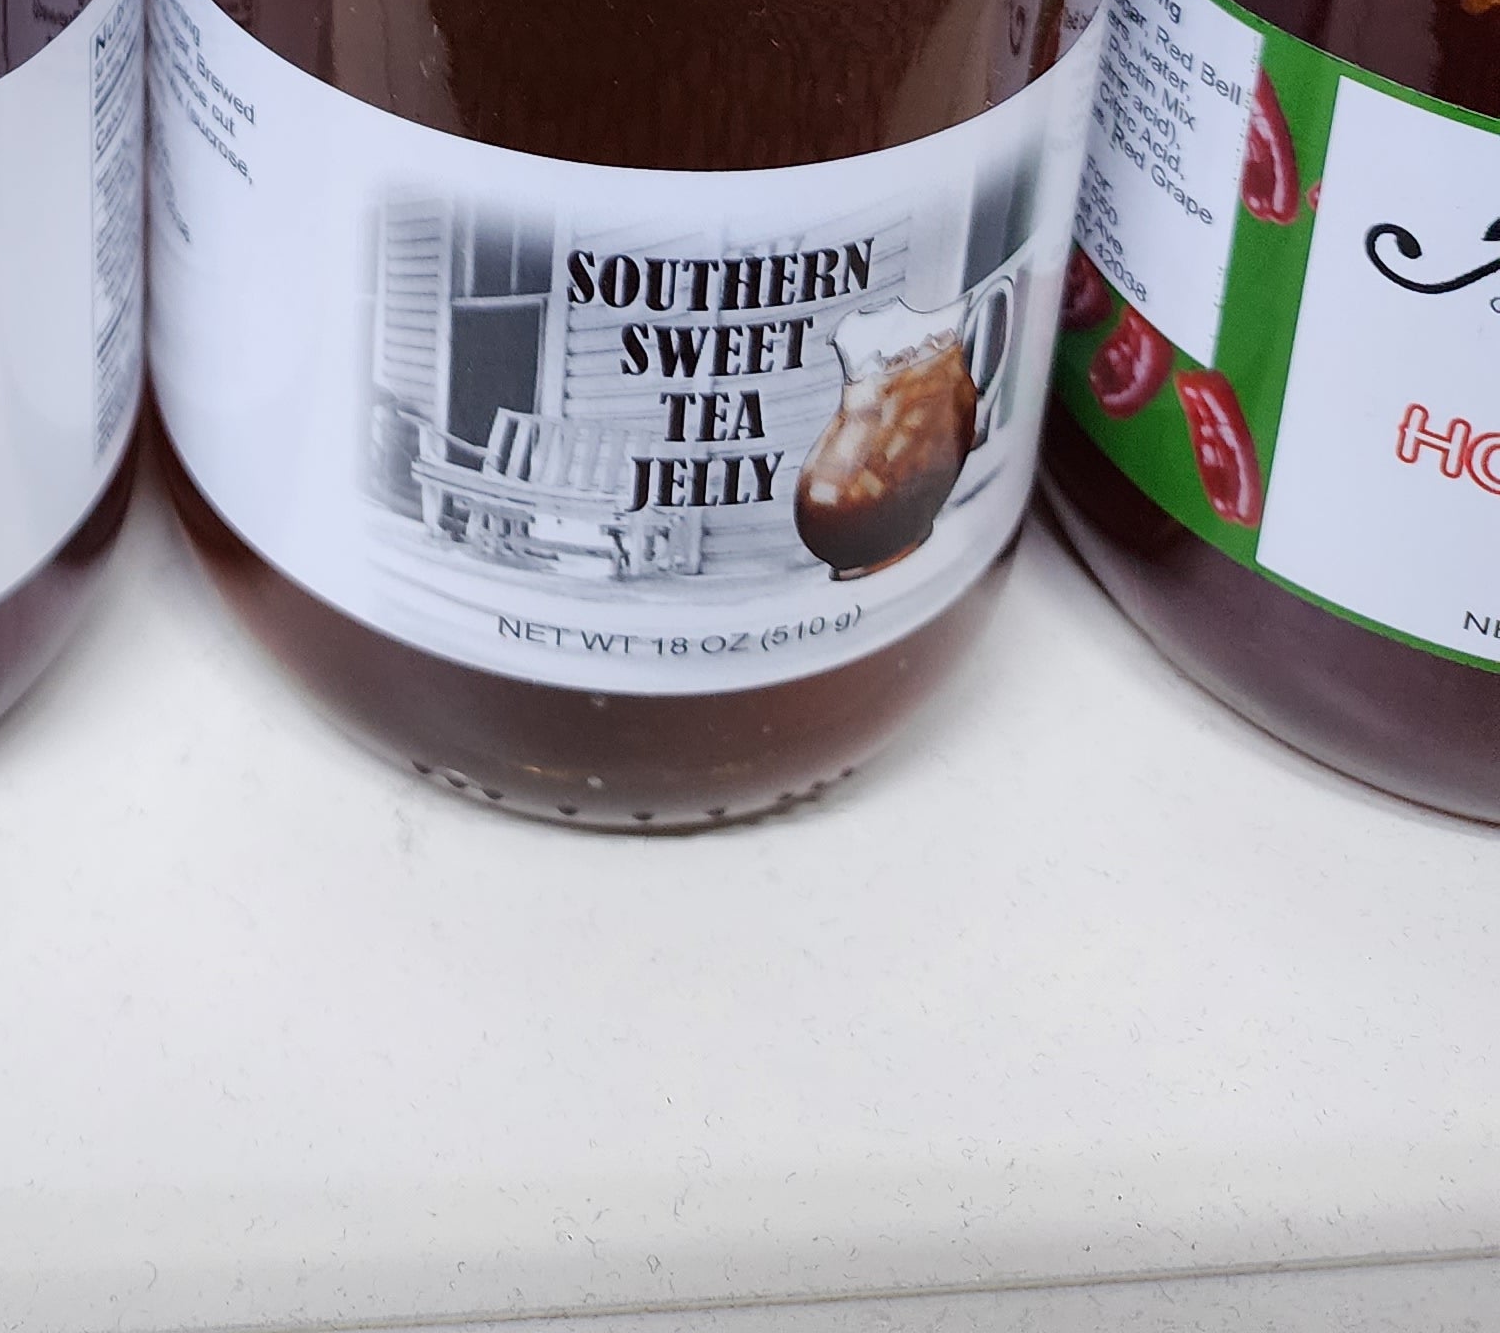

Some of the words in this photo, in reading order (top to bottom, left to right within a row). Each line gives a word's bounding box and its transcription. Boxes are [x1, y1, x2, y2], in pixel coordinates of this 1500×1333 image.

[196, 53, 256, 125] Brewed
[1108, 34, 1157, 99] Pectin
[1161, 87, 1197, 132] Mix
[1138, 41, 1191, 102] water,
[1155, 24, 1194, 73] Red
[1200, 60, 1242, 106] Bell
[1138, 127, 1186, 181] Acid,
[1150, 163, 1213, 225] Grape
[566, 236, 875, 312] SOUTHERN
[619, 315, 814, 379] SWEET
[658, 388, 766, 442] TEA
[624, 449, 786, 513] JELLY
[497, 614, 571, 648] NET
[580, 630, 640, 655] WT
[651, 636, 689, 657] 18
[701, 632, 750, 654] OZ
[759, 616, 828, 652] (510
